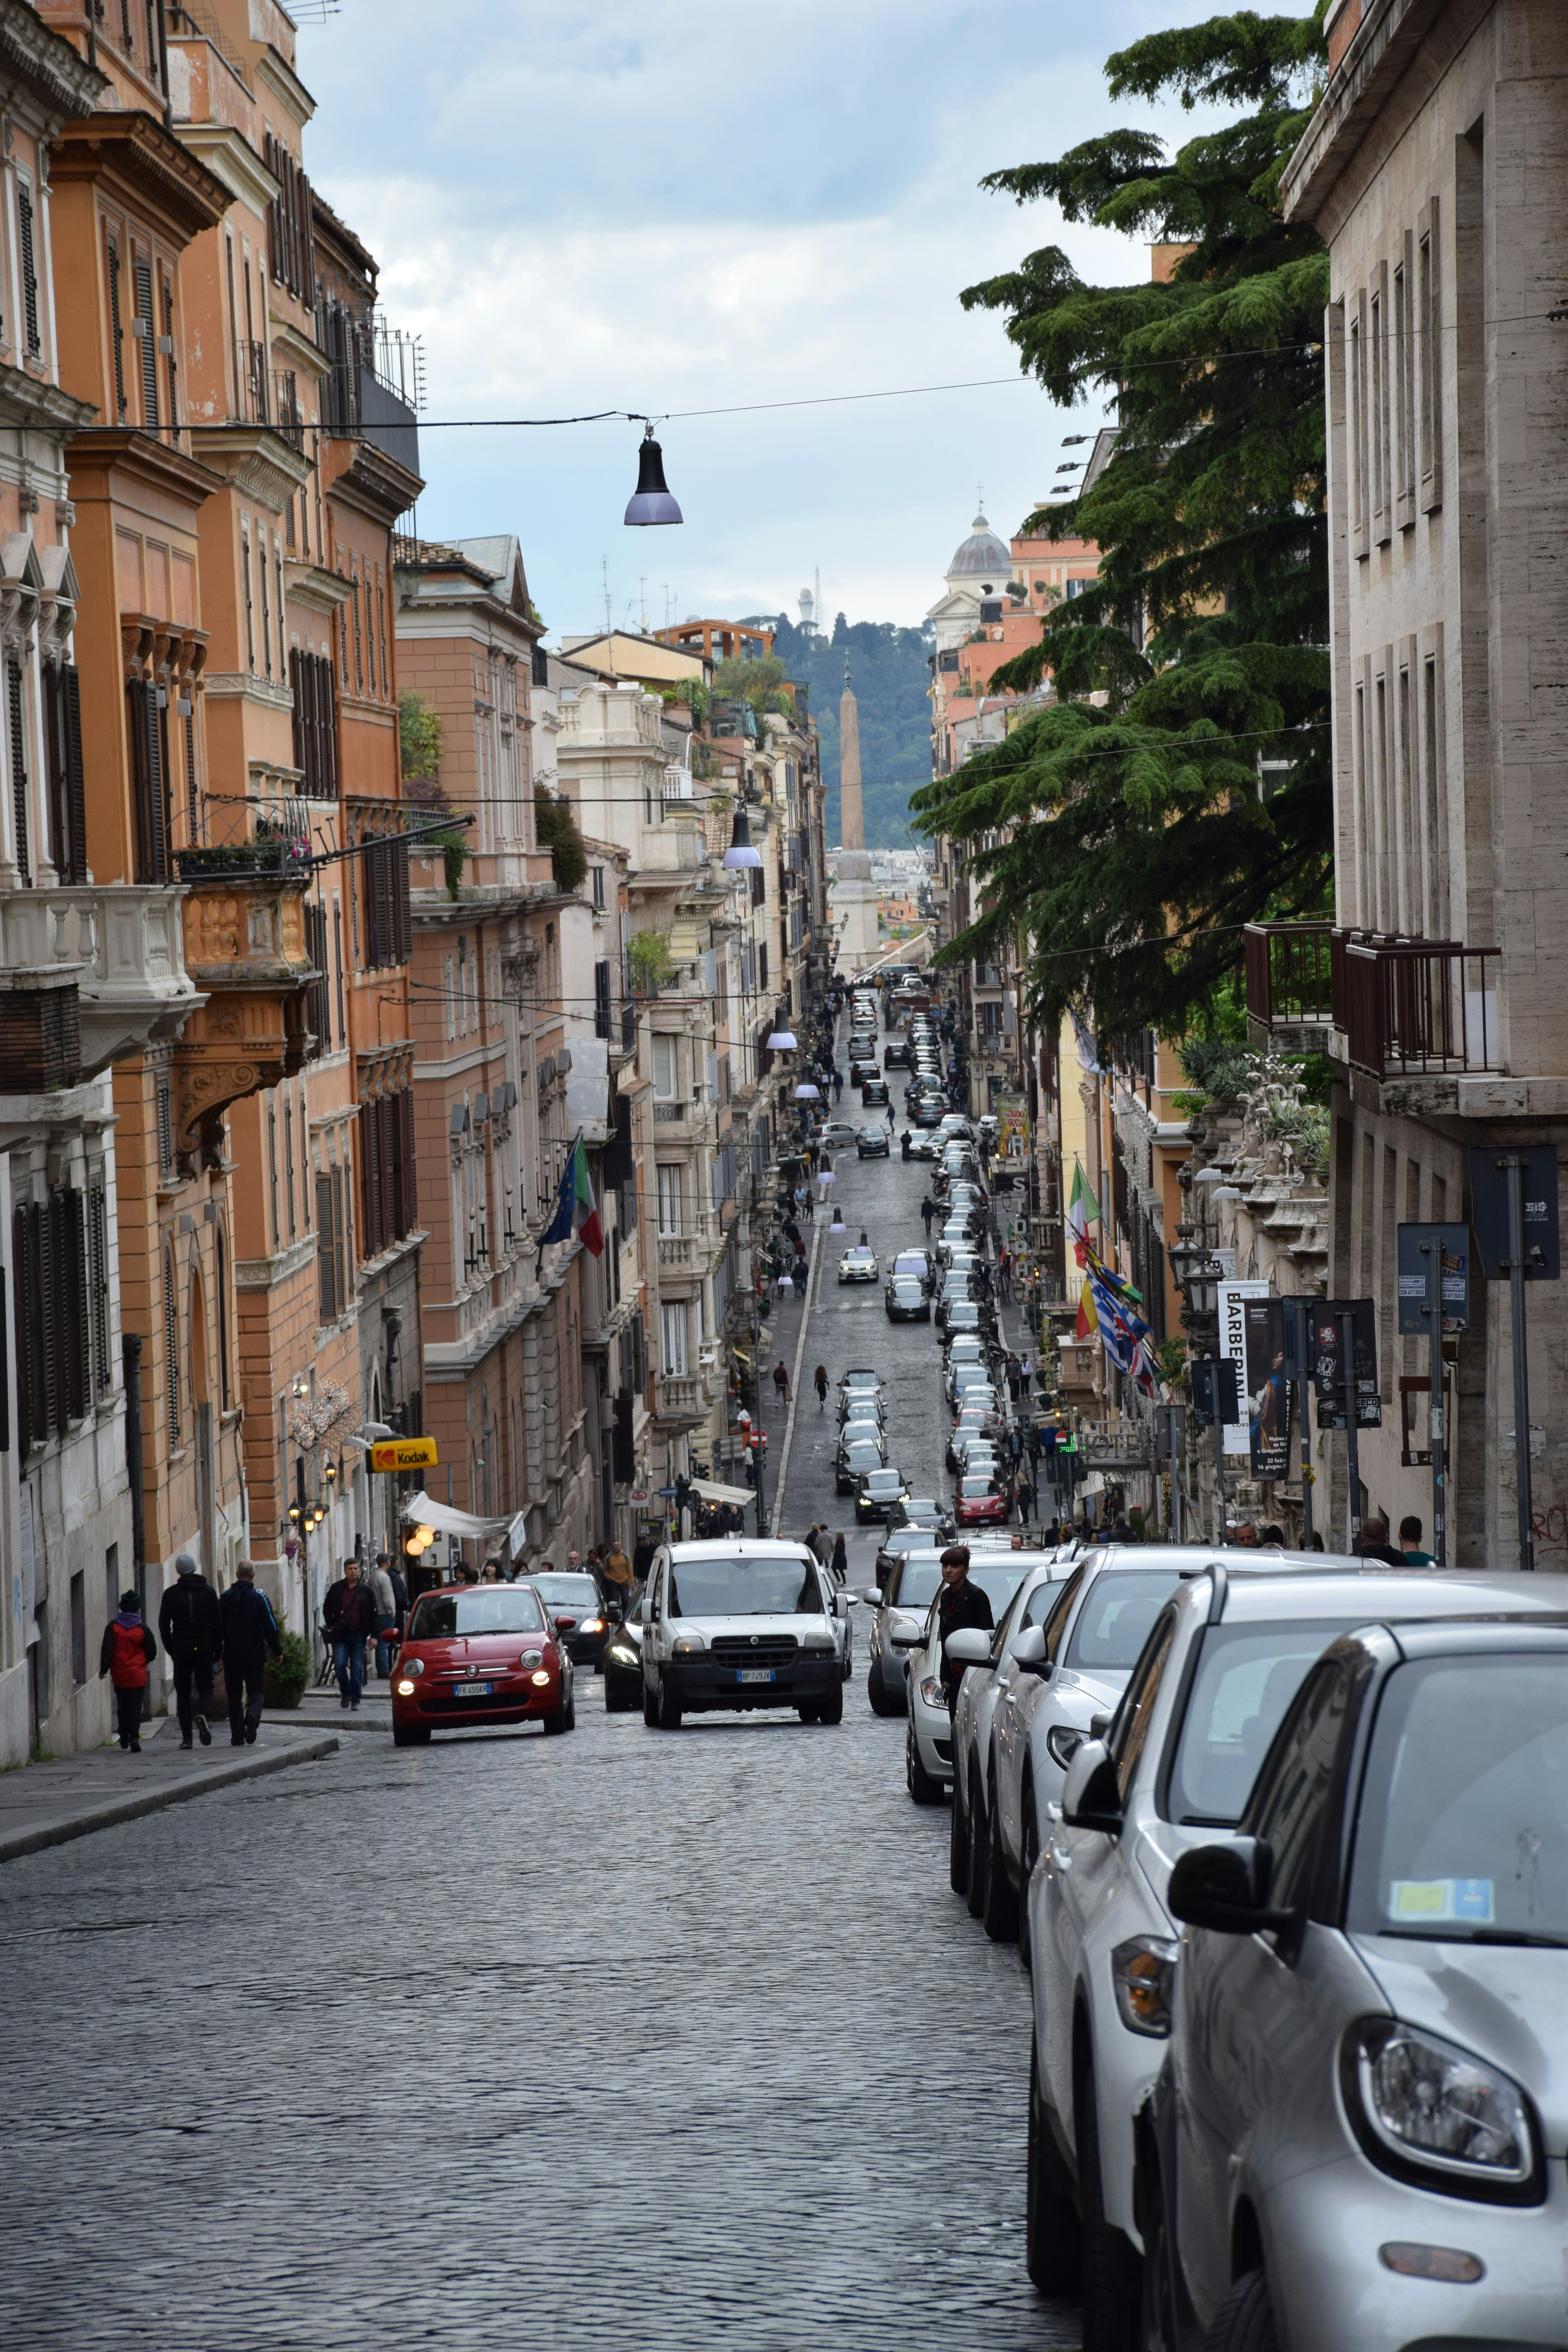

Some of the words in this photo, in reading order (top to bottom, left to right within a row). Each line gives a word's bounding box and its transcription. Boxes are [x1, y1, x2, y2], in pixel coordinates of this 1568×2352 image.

[1011, 1109, 1025, 1118] BUONA
[1008, 1118, 1022, 1127] GIUSTA
[1012, 1135, 1031, 1339] RISTORATE
[397, 1451, 430, 1464] Kodak
[468, 1685, 486, 1693] 455KH
